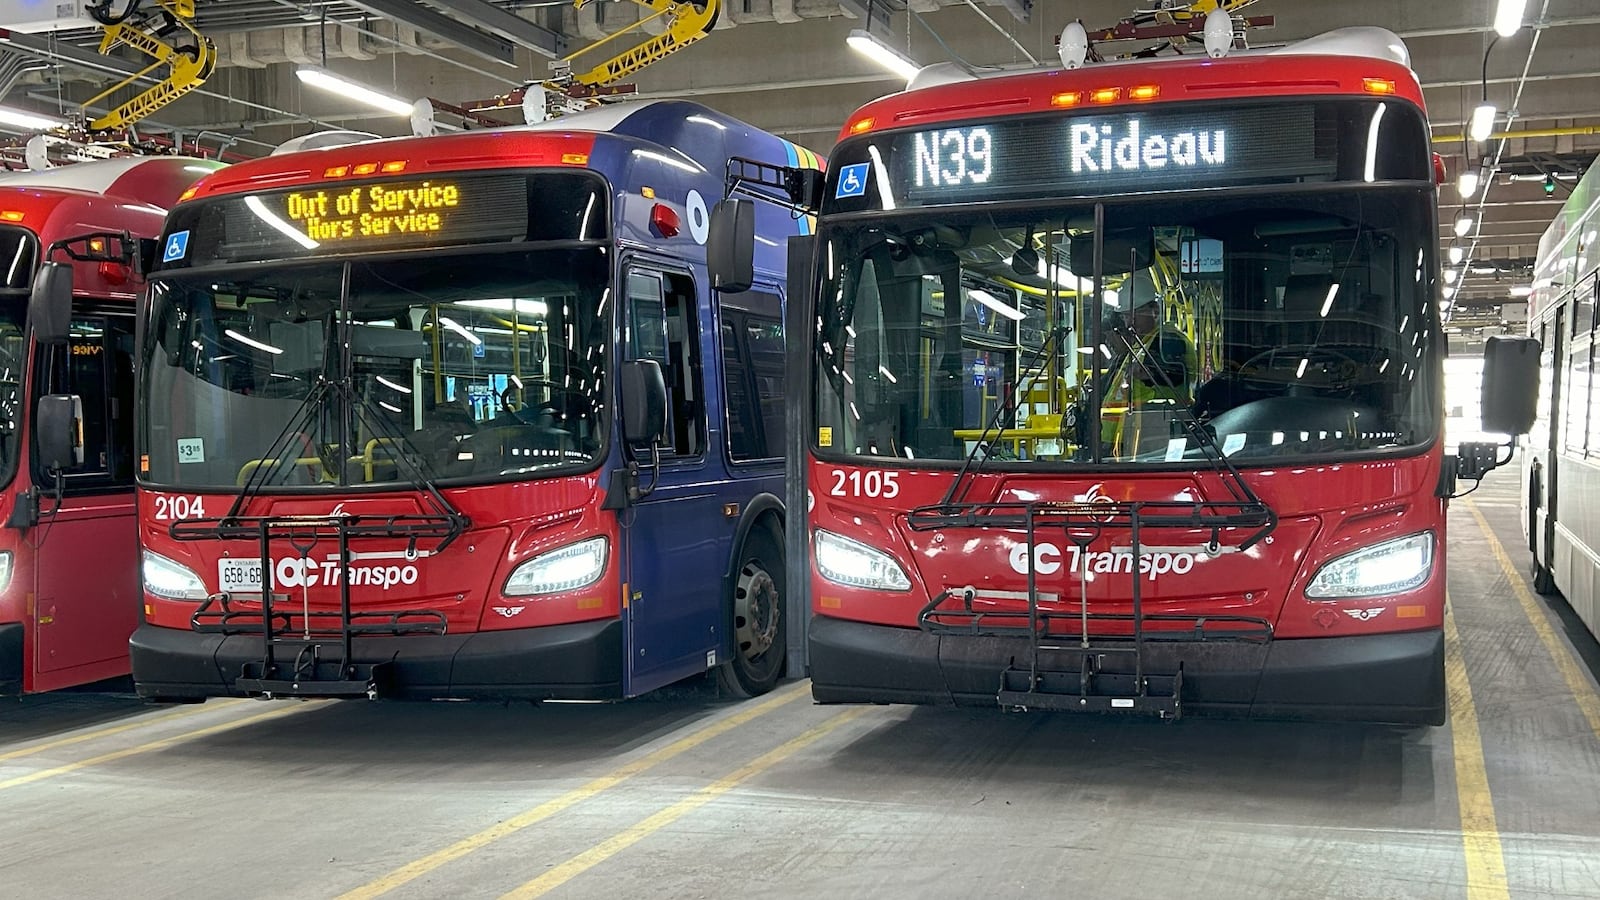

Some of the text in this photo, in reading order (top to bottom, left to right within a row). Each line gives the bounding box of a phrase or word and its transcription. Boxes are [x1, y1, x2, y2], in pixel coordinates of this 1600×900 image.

[914, 120, 1225, 186] N39 Rideau
[287, 182, 458, 220] Out of Service
[307, 209, 440, 240] Hors Service
[831, 470, 899, 498] 2105
[155, 496, 205, 520] 2104
[224, 567, 262, 583] 658 6B
[276, 557, 418, 589] OC Transpo
[1009, 543, 1194, 580] OC Transpo
